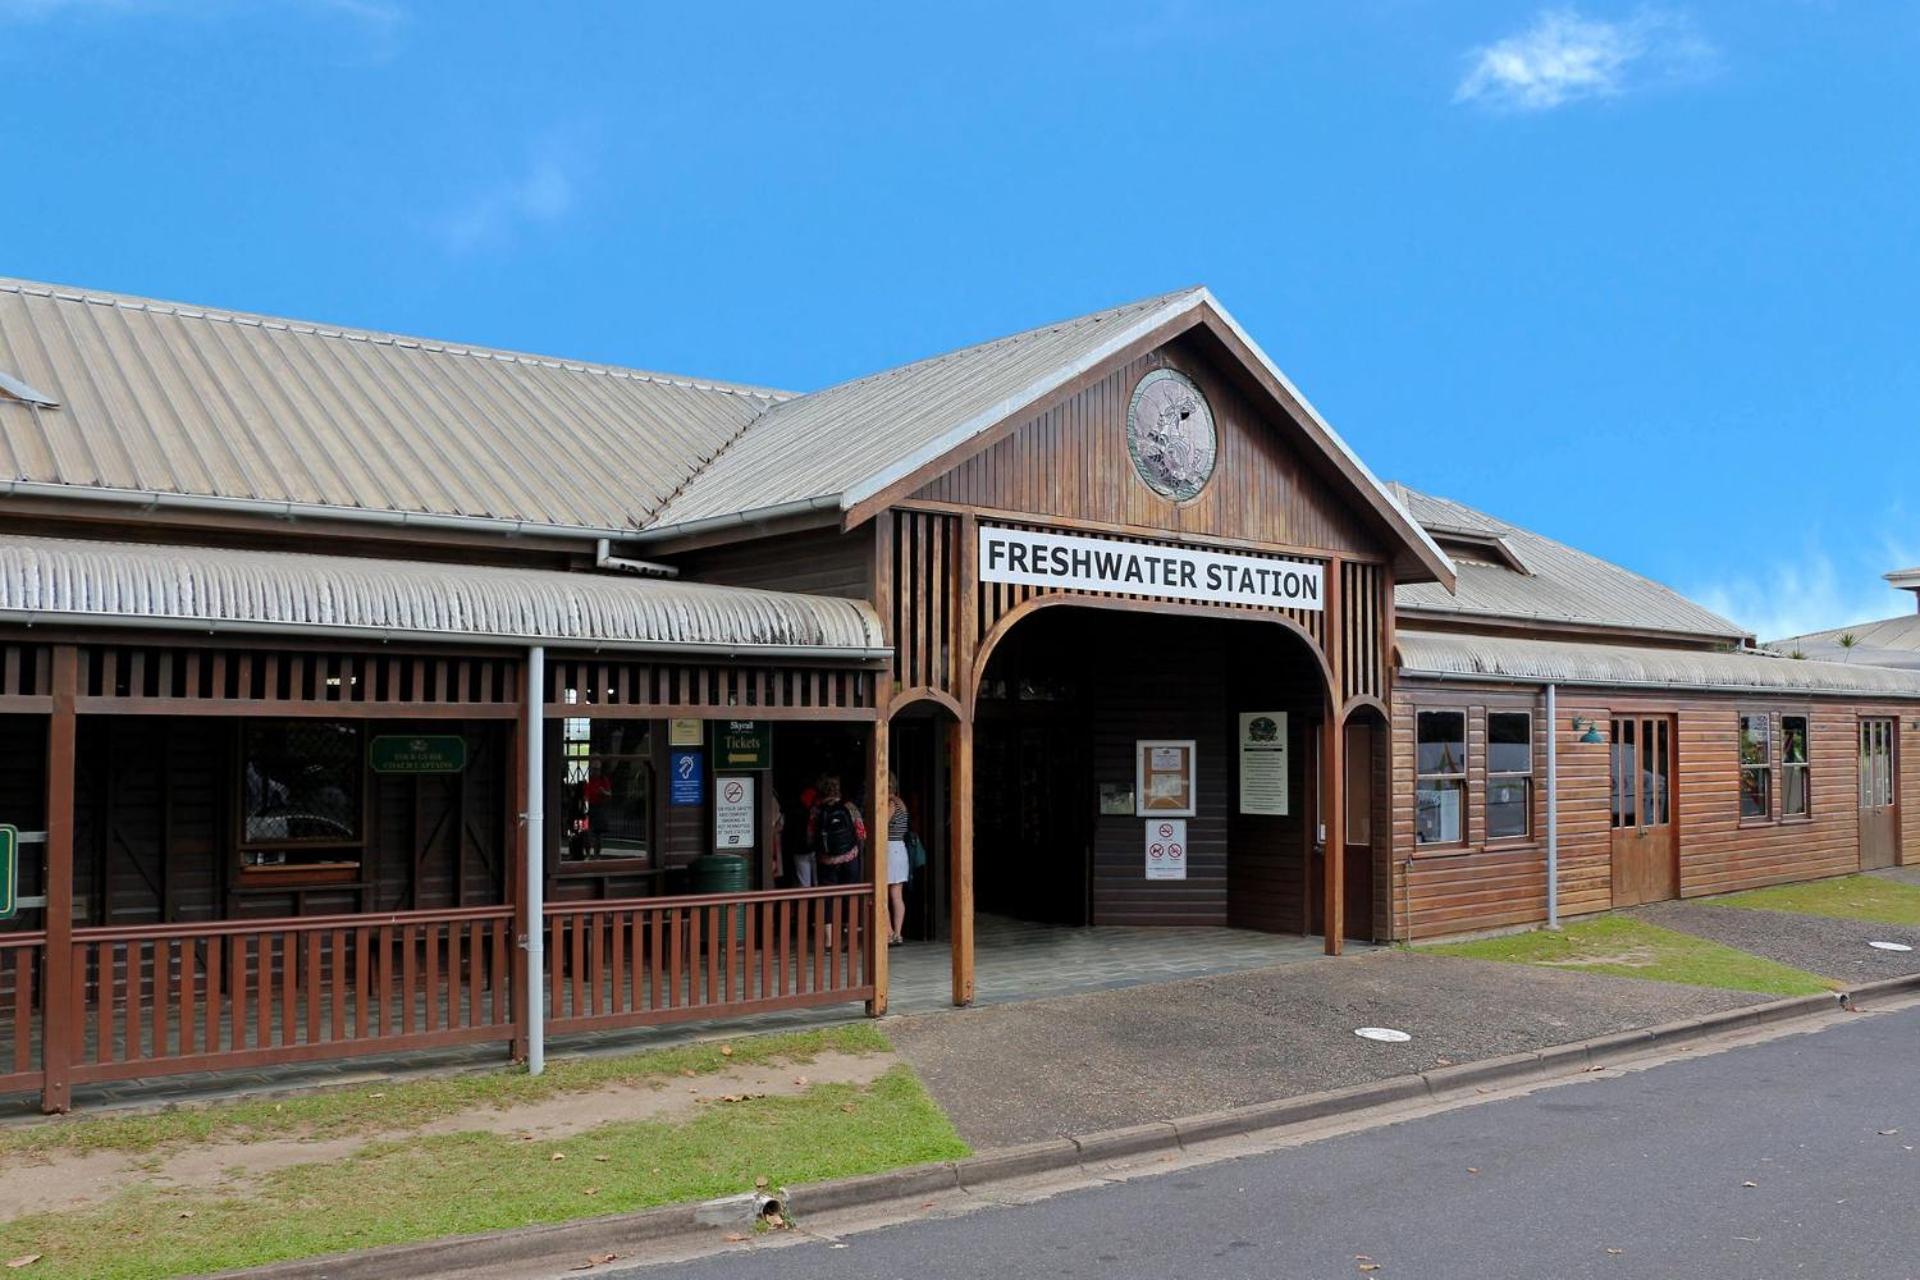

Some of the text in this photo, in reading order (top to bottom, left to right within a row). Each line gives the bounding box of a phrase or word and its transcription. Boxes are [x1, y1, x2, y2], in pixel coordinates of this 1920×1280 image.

[988, 540, 1317, 600] FRESHWATER STATION
[723, 735, 760, 749] Tickets
